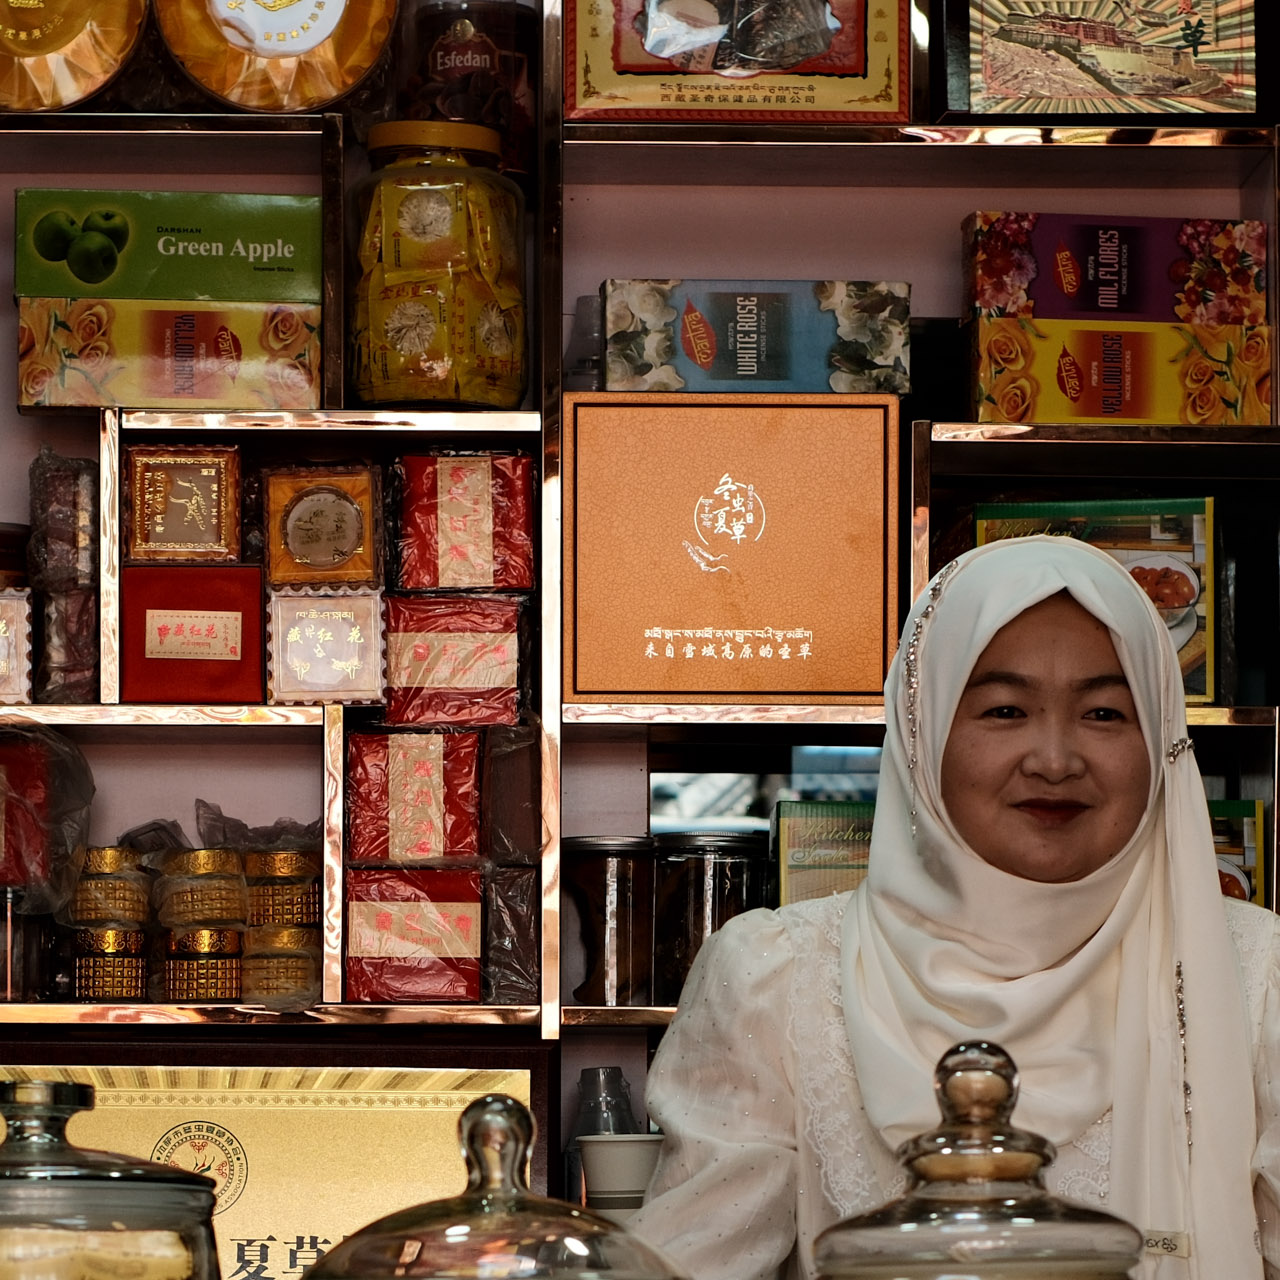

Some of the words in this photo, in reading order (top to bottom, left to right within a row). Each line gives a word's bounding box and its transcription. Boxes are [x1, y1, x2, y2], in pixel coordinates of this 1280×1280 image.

[437, 51, 490, 70] Esfedan
[157, 226, 201, 234] DARSHAN
[157, 235, 224, 257] Green
[230, 237, 295, 262] Apple
[1098, 230, 1119, 281] FLORES
[1056, 250, 1078, 294] mantra
[1098, 285, 1119, 308] MIL
[737, 297, 757, 331] ROSE
[174, 314, 195, 362] YELLOW
[684, 311, 713, 364] mantra
[737, 333, 757, 375] WHITE
[1102, 334, 1122, 362] ROSE
[174, 364, 194, 395] ROSE
[1060, 356, 1080, 398] mantra
[1102, 365, 1122, 415] YELLOW
[714, 473, 747, 544] 冬虫夏草
[173, 623, 219, 639] 藏红花
[286, 625, 365, 644] 藏红花
[644, 642, 813, 660] 来自雪域高原的圣草
[224, 1162, 244, 1205] ASSOCIATION
